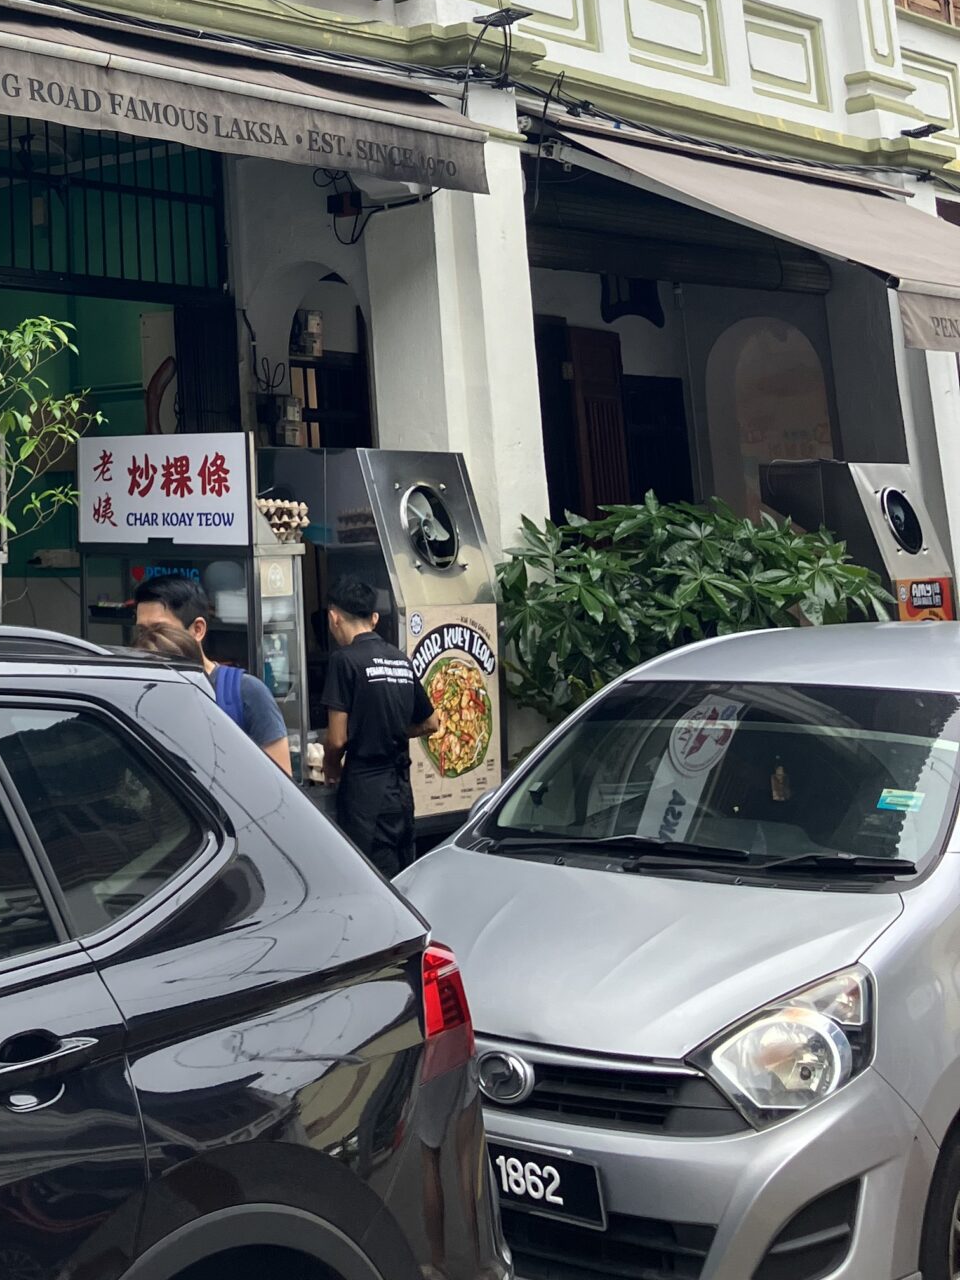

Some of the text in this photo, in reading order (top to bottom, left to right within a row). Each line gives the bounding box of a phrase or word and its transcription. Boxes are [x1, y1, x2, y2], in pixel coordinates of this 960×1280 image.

[27, 77, 101, 113] ROAD
[109, 92, 209, 134] FAMOUS
[212, 115, 288, 146] LAKSA
[307, 129, 352, 158] EST.
[356, 139, 415, 169] SINCE
[127, 452, 230, 498] 炒粿條
[126, 512, 234, 526] CHAR KOAY TEOW
[412, 627, 495, 677] CHAR KUEY TEOW
[495, 1155, 564, 1206] 1862
